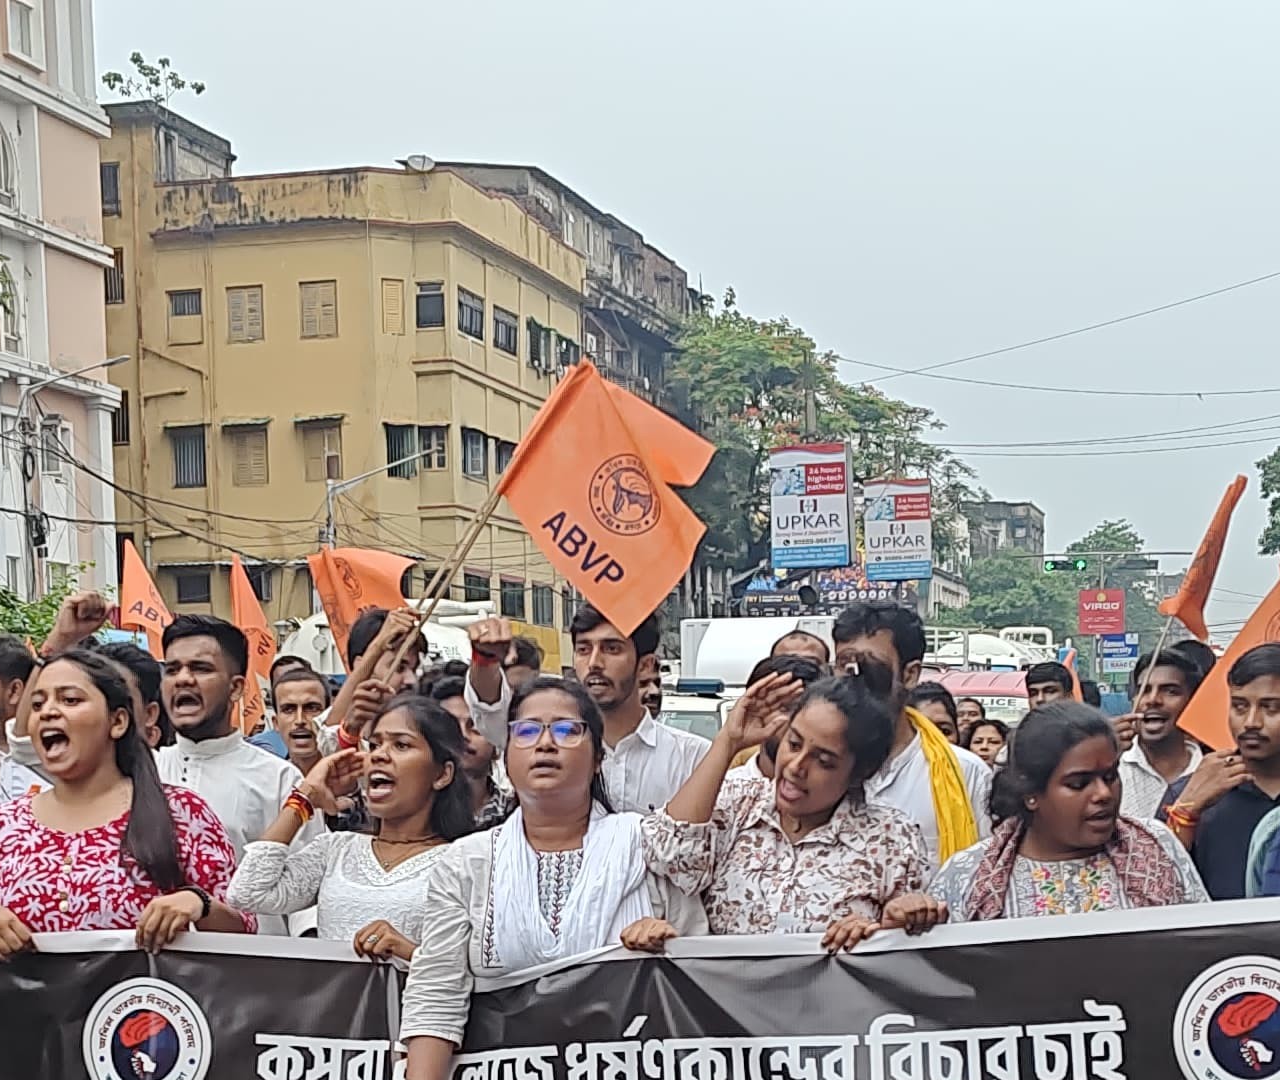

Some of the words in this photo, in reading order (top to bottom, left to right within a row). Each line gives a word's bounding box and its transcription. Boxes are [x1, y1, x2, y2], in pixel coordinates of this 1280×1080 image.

[777, 513, 841, 530] UPKAR
[541, 511, 625, 584] ABVP
[869, 535, 926, 549] UPKAR
[982, 698, 1017, 706] LICE
